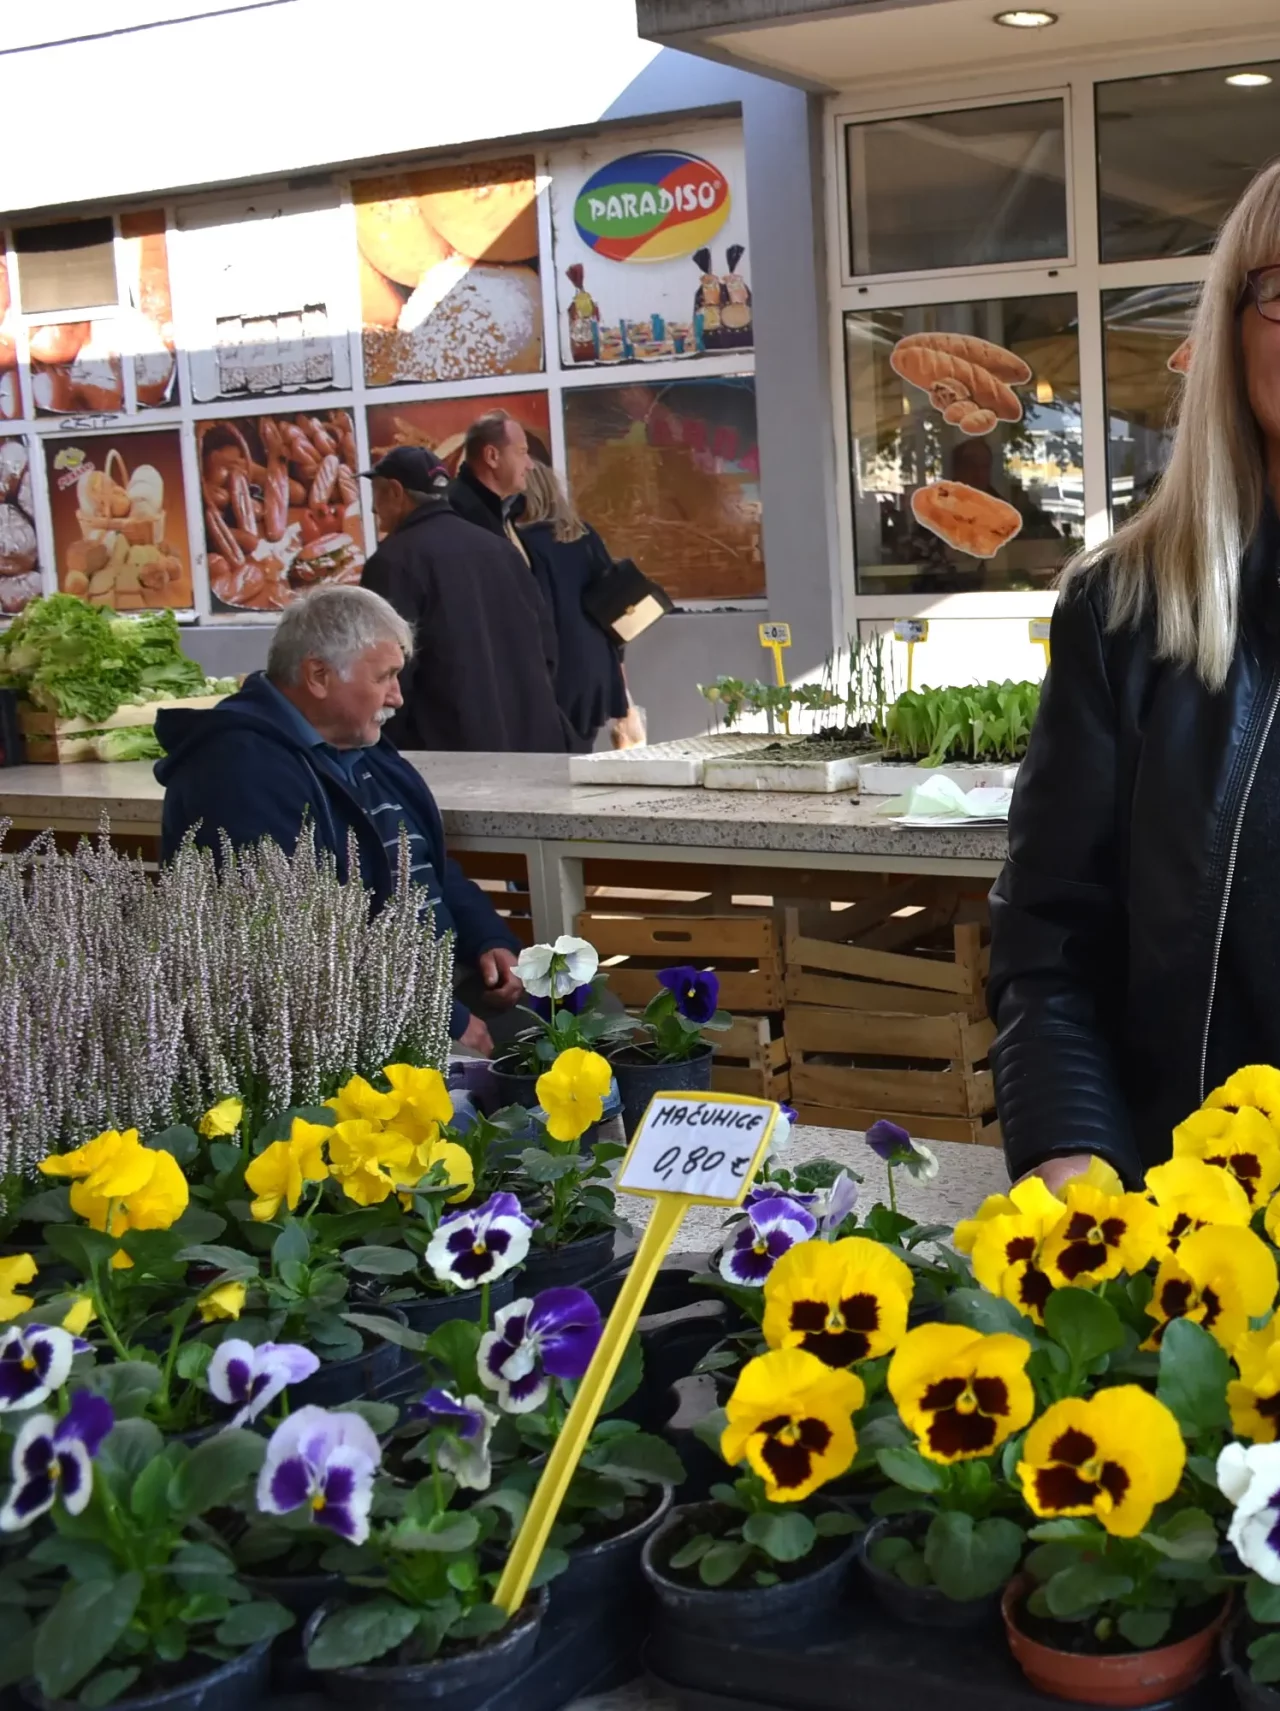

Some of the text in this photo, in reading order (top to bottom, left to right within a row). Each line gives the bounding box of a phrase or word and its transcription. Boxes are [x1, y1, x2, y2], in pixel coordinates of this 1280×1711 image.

[588, 181, 715, 222] PARADISO
[653, 1146, 749, 1181] 0,80 €
